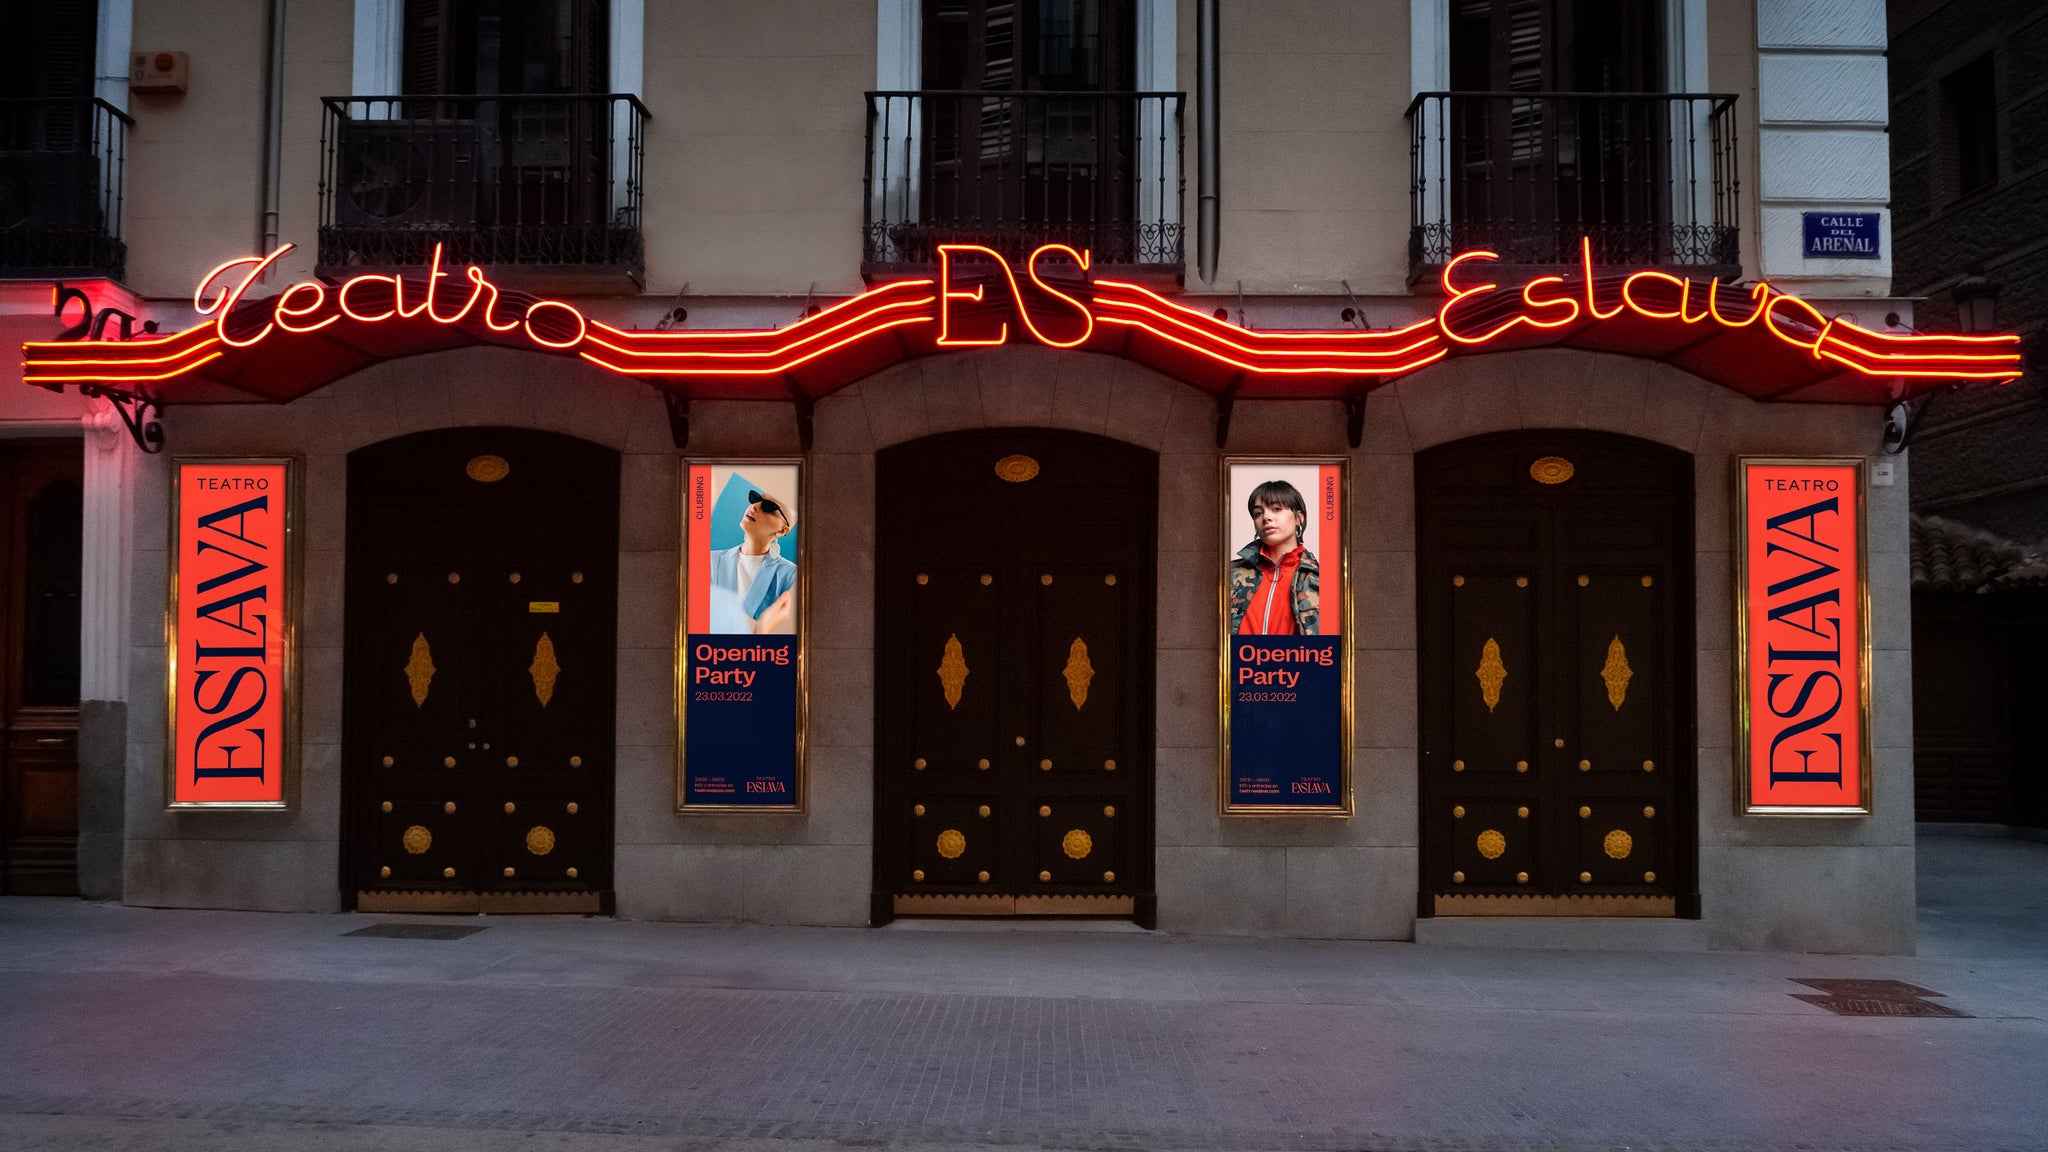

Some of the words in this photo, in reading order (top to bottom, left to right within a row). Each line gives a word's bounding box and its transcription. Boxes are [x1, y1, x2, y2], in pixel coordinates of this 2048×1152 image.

[1821, 217, 1863, 228] CALLE
[1811, 237, 1874, 252] ARENAL
[195, 241, 586, 348] Teatro
[936, 243, 1093, 348] ES
[1439, 235, 1832, 360] Eslava
[197, 478, 269, 490] TEATRO
[1765, 479, 1839, 491] TEATRO
[696, 476, 704, 520] CLUBBING
[1326, 476, 1334, 520] CLUBBING
[193, 495, 269, 787] ESLAVA
[1766, 496, 1843, 791] ESLAVA
[695, 644, 789, 666] Opening
[1239, 644, 1334, 666] Opening
[695, 667, 756, 688] Party
[1239, 667, 1300, 689] Party
[695, 691, 753, 702] 23.03.2022
[1238, 692, 1297, 702] 23.03.2022
[746, 781, 786, 793] ESLAVA
[1290, 782, 1332, 794] ESLAVA
